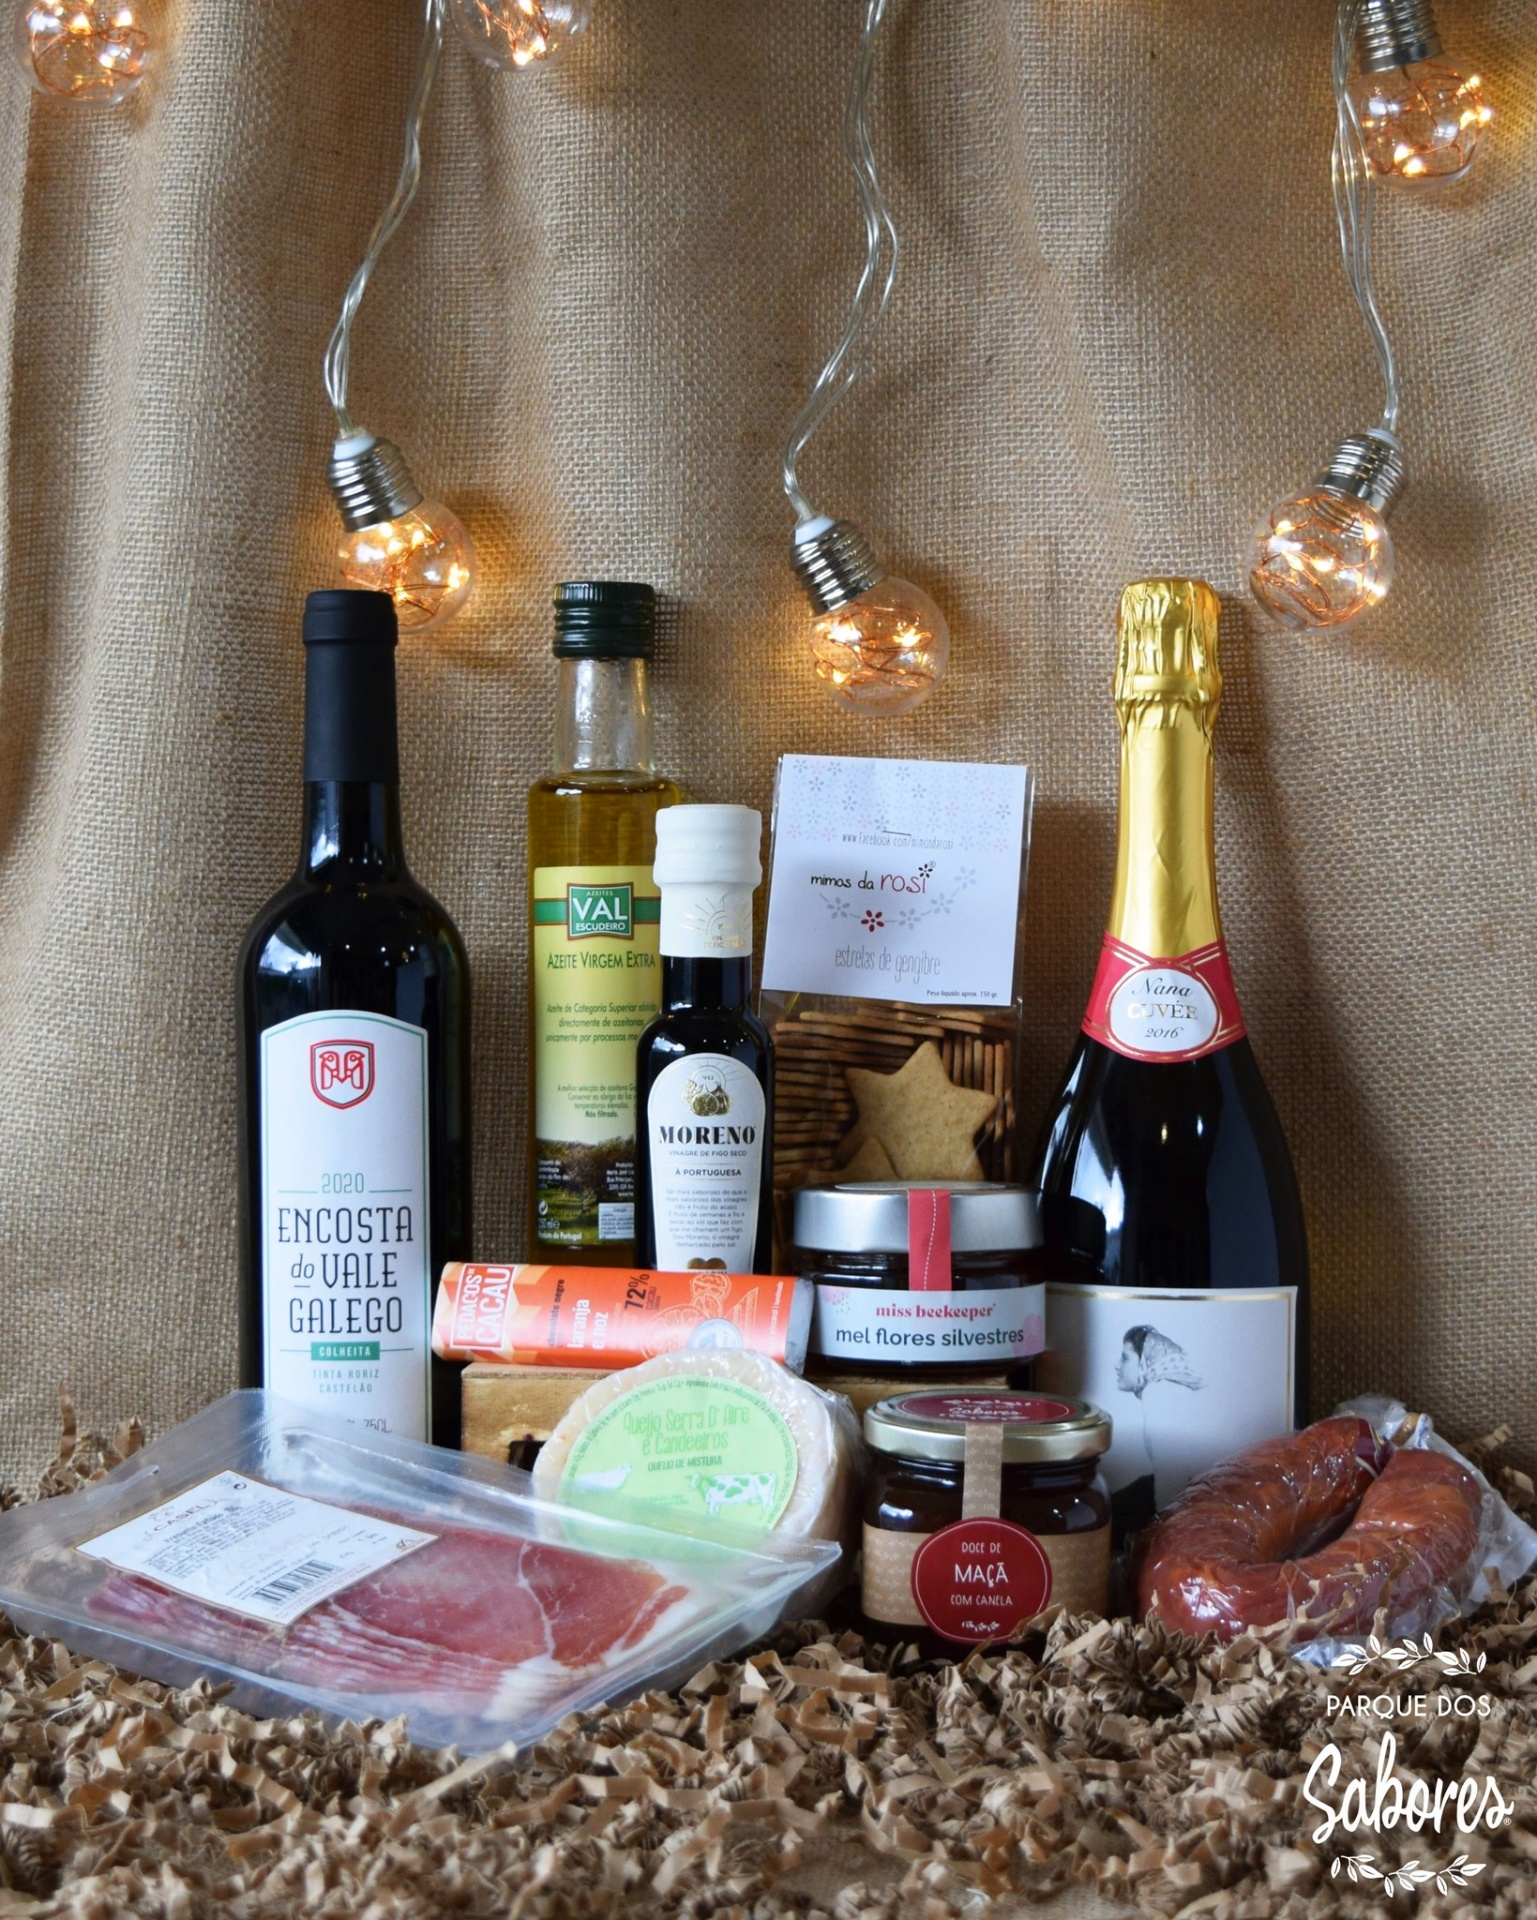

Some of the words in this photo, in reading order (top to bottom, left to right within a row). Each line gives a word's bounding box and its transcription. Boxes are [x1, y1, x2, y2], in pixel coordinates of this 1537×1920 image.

[810, 874, 852, 889] mimos
[857, 870, 874, 890] da
[880, 872, 927, 894] rosi
[573, 897, 628, 920] VAL
[575, 922, 626, 931] ESCUDEIRO
[835, 945, 875, 970] estrelas
[879, 947, 891, 971] de
[896, 951, 940, 983] gengibre
[1132, 977, 1193, 997] Nana
[547, 1004, 563, 1013] Azeite
[565, 1003, 572, 1013] de
[574, 1003, 607, 1015] Categoria
[608, 1002, 637, 1015] Superior
[1127, 1000, 1199, 1020] CUVÉE
[602, 1017, 612, 1027] de
[580, 1034, 591, 1044] por
[1145, 1027, 1184, 1039] 2016
[660, 1126, 755, 1145] MORENO
[322, 1173, 365, 1194] 2020
[278, 1206, 413, 1244] ENCOSTA
[291, 1253, 315, 1279] do
[321, 1252, 398, 1289] VALE
[554, 1279, 565, 1303] negro
[625, 1274, 650, 1310] 72%
[476, 1267, 511, 1343] CACAU
[876, 1304, 912, 1318] miss
[916, 1304, 993, 1321] beekeeper
[290, 1297, 402, 1334] GALEGO
[567, 1299, 591, 1348] laranja
[593, 1312, 609, 1337] noz
[592, 1340, 605, 1350] e
[836, 1327, 870, 1345] mel
[876, 1327, 935, 1346] flores
[942, 1328, 1024, 1346] silvestres
[319, 1346, 371, 1357] COLHEITA
[313, 1369, 342, 1379] TINTA
[348, 1368, 379, 1379] RORIZ
[319, 1382, 373, 1393] CASTELÃO
[623, 1411, 662, 1436] Queijo
[666, 1409, 704, 1432] Serra
[724, 1403, 749, 1426] Aire
[642, 1438, 651, 1456] e
[655, 1430, 729, 1455] Candeeiros
[647, 1458, 675, 1472] QUEIJO
[675, 1458, 686, 1469] DE
[687, 1455, 723, 1468] MISTURA
[152, 1502, 211, 1533] CASEL
[961, 1542, 985, 1554] DOCE
[990, 1542, 1001, 1553] DE
[955, 1562, 1009, 1588] MAÇÃ
[950, 1594, 972, 1606] COM
[976, 1594, 1013, 1606] CANELA
